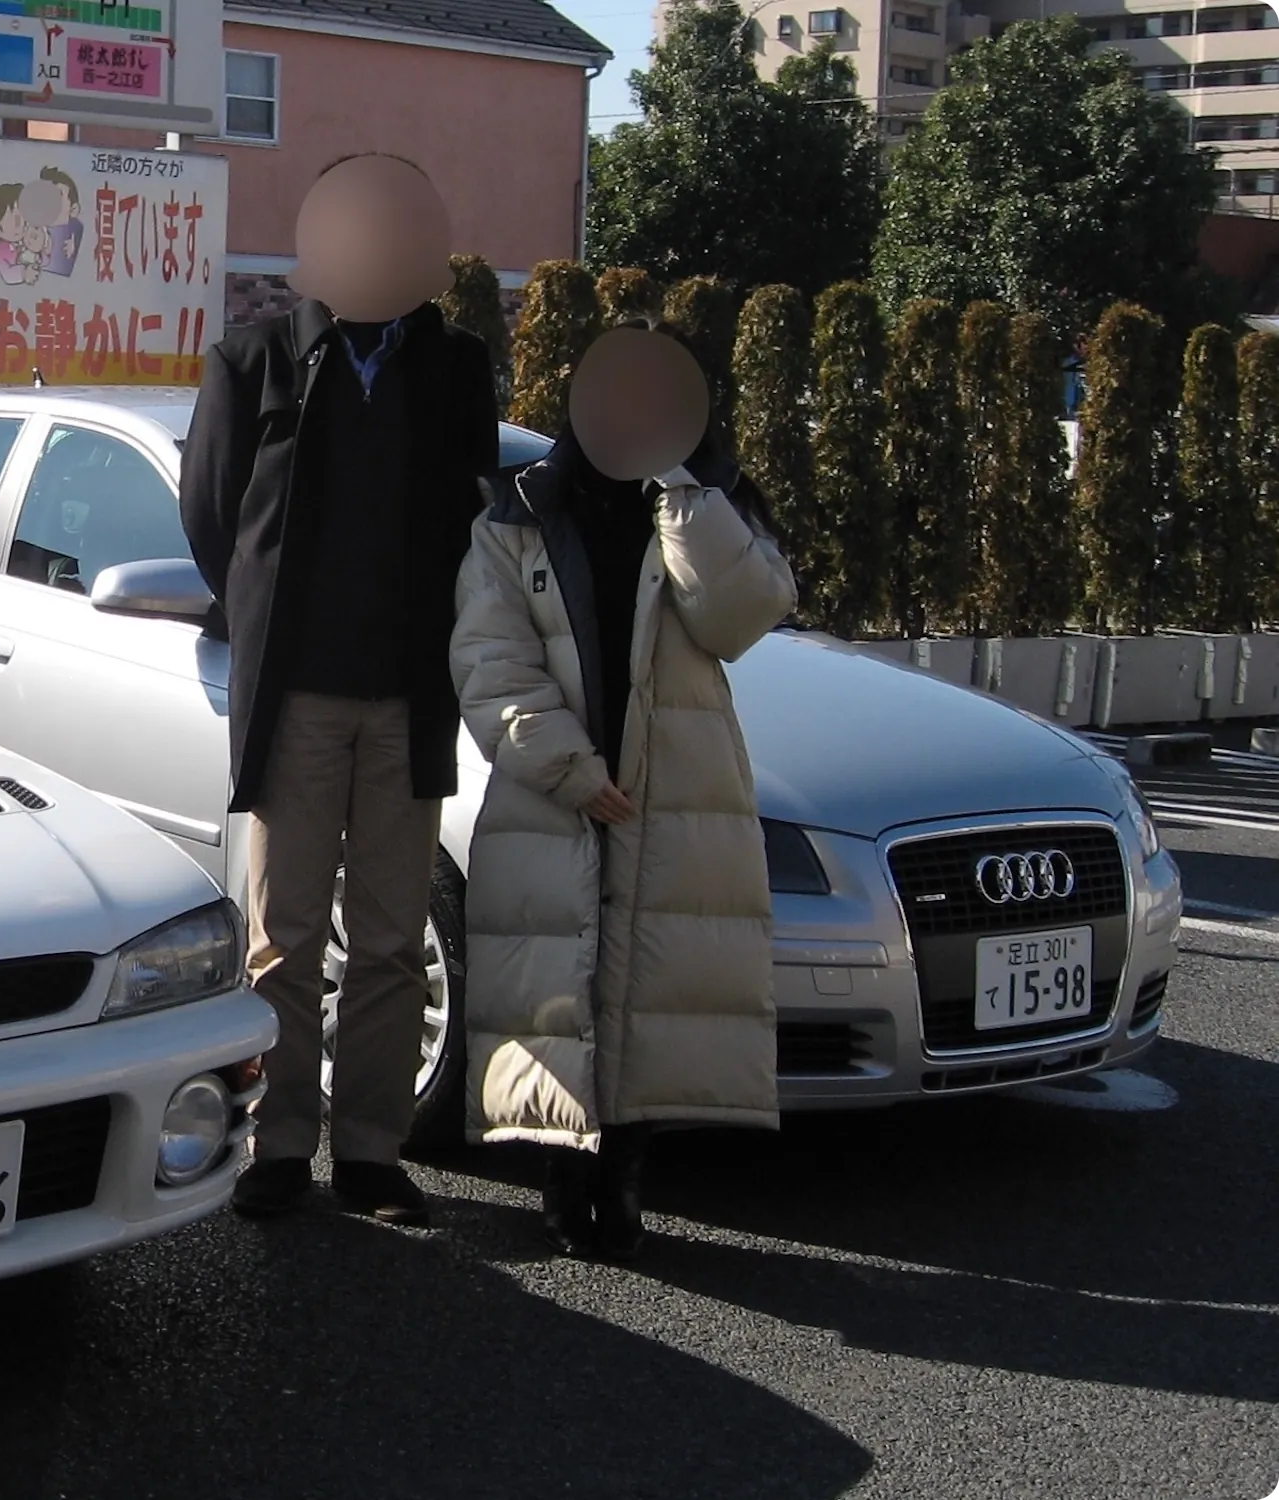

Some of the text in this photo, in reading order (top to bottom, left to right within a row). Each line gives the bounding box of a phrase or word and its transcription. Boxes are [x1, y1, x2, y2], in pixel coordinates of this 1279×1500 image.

[77, 43, 150, 70] 桃太郎すし
[37, 63, 60, 79] 入口
[82, 68, 144, 89] 西一之江店
[90, 153, 184, 179] 近隣の方々が
[92, 180, 211, 285] 寝ています。
[1008, 964, 1085, 1018] 15-98
